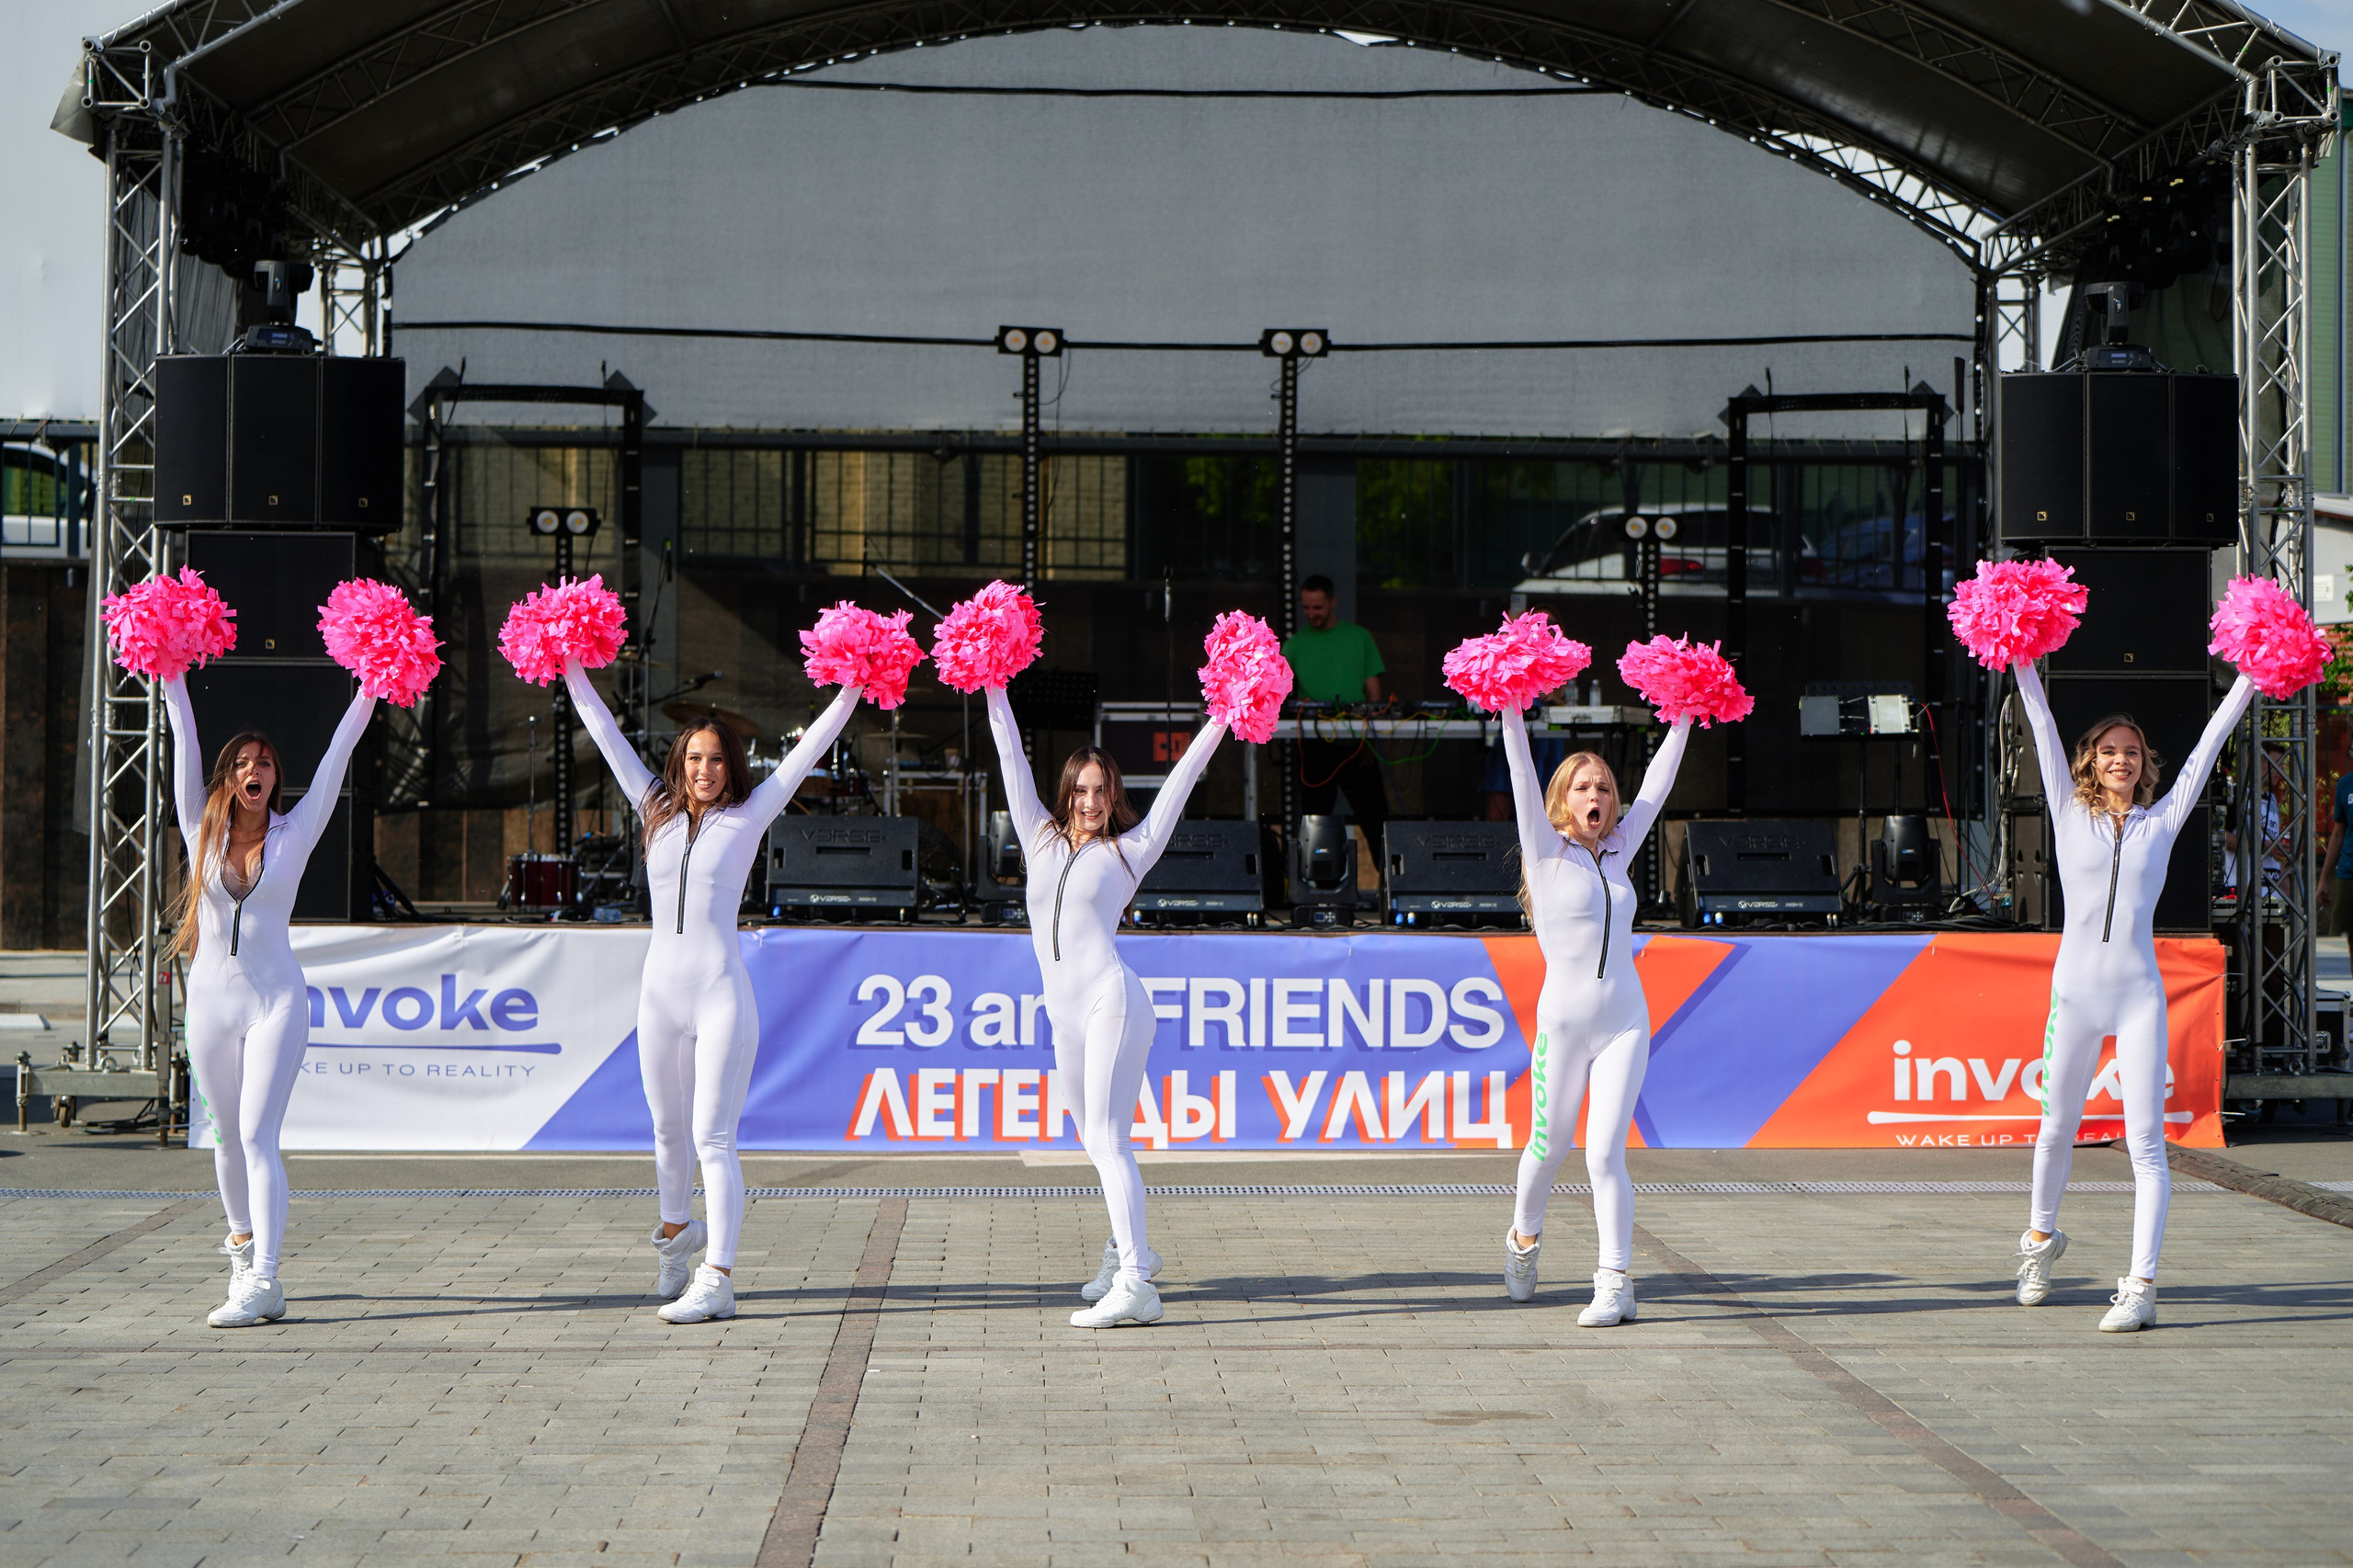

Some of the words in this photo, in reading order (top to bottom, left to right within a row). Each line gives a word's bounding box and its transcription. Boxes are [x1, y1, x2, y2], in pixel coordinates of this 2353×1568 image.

[306, 973, 539, 1031] voke
[856, 974, 954, 1047] 23
[970, 993, 1054, 1046] an
[301, 1062, 328, 1074] KE
[339, 1063, 370, 1074] UP
[382, 1064, 415, 1075] TO
[427, 1065, 535, 1076] REALITY
[1529, 1032, 1548, 1162] invoke
[1269, 1070, 1512, 1149] УЛИЦ
[1895, 1134, 1971, 1146] WAKE
[1981, 1135, 2013, 1145] UP
[2023, 1134, 2037, 1144] T
